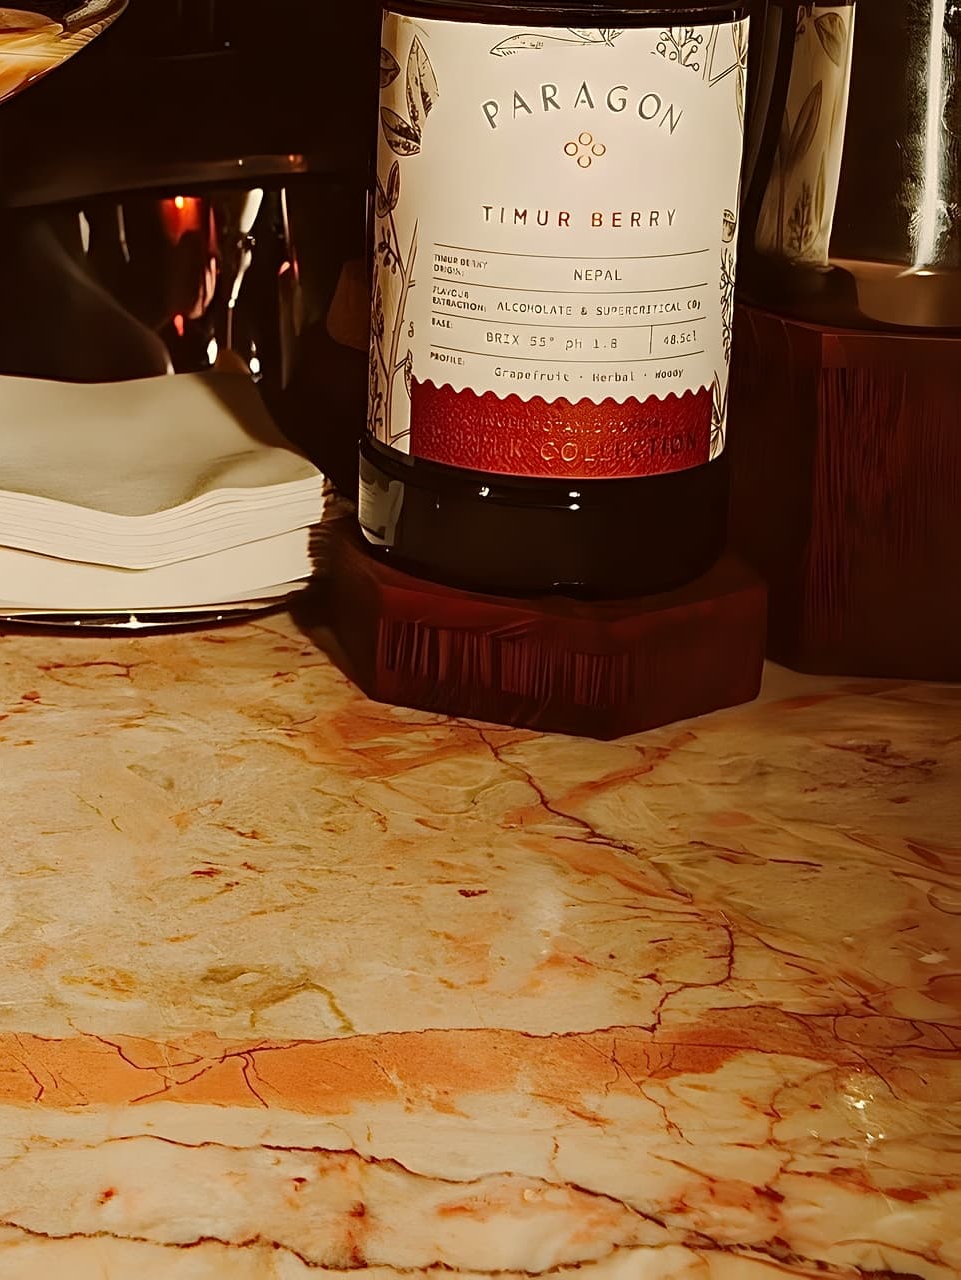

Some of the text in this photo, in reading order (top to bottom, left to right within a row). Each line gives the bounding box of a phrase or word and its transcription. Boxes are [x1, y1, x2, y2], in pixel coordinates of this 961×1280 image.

[482, 81, 682, 135] PARAGON
[483, 206, 676, 228] TIMUR BERRY
[573, 269, 622, 281] NEPAL
[580, 306, 588, 316] &
[486, 331, 520, 345] BRIX
[494, 367, 570, 382] Grapefruit
